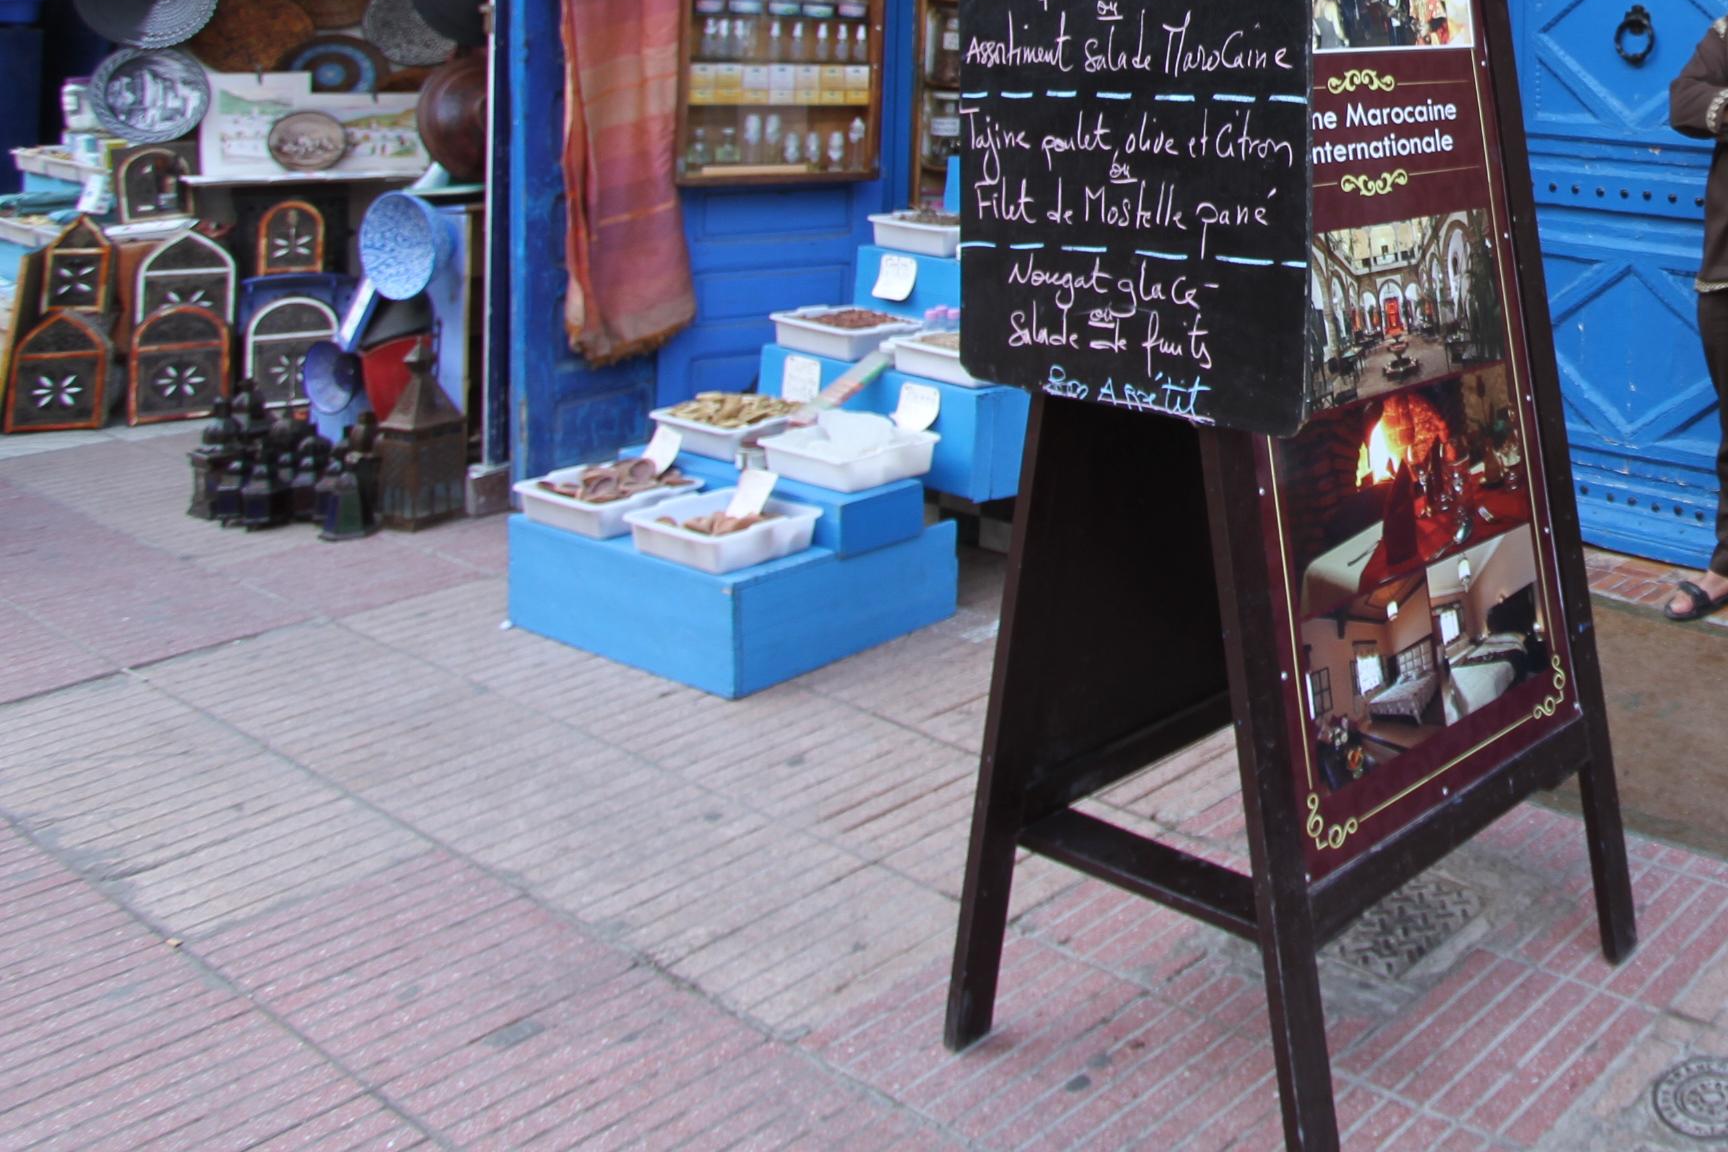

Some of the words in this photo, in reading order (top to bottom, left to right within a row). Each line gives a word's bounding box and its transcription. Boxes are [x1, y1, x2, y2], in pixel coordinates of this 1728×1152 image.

[1346, 98, 1457, 129] Marocaine
[959, 108, 1031, 185] Tajine
[1125, 111, 1179, 156] olive
[1189, 108, 1209, 158] et
[1312, 128, 1454, 165] nternationale
[1047, 177, 1073, 225] de
[1008, 252, 1112, 310] Nougat
[1008, 300, 1080, 350] Salade
[1142, 311, 1213, 378] fruits
